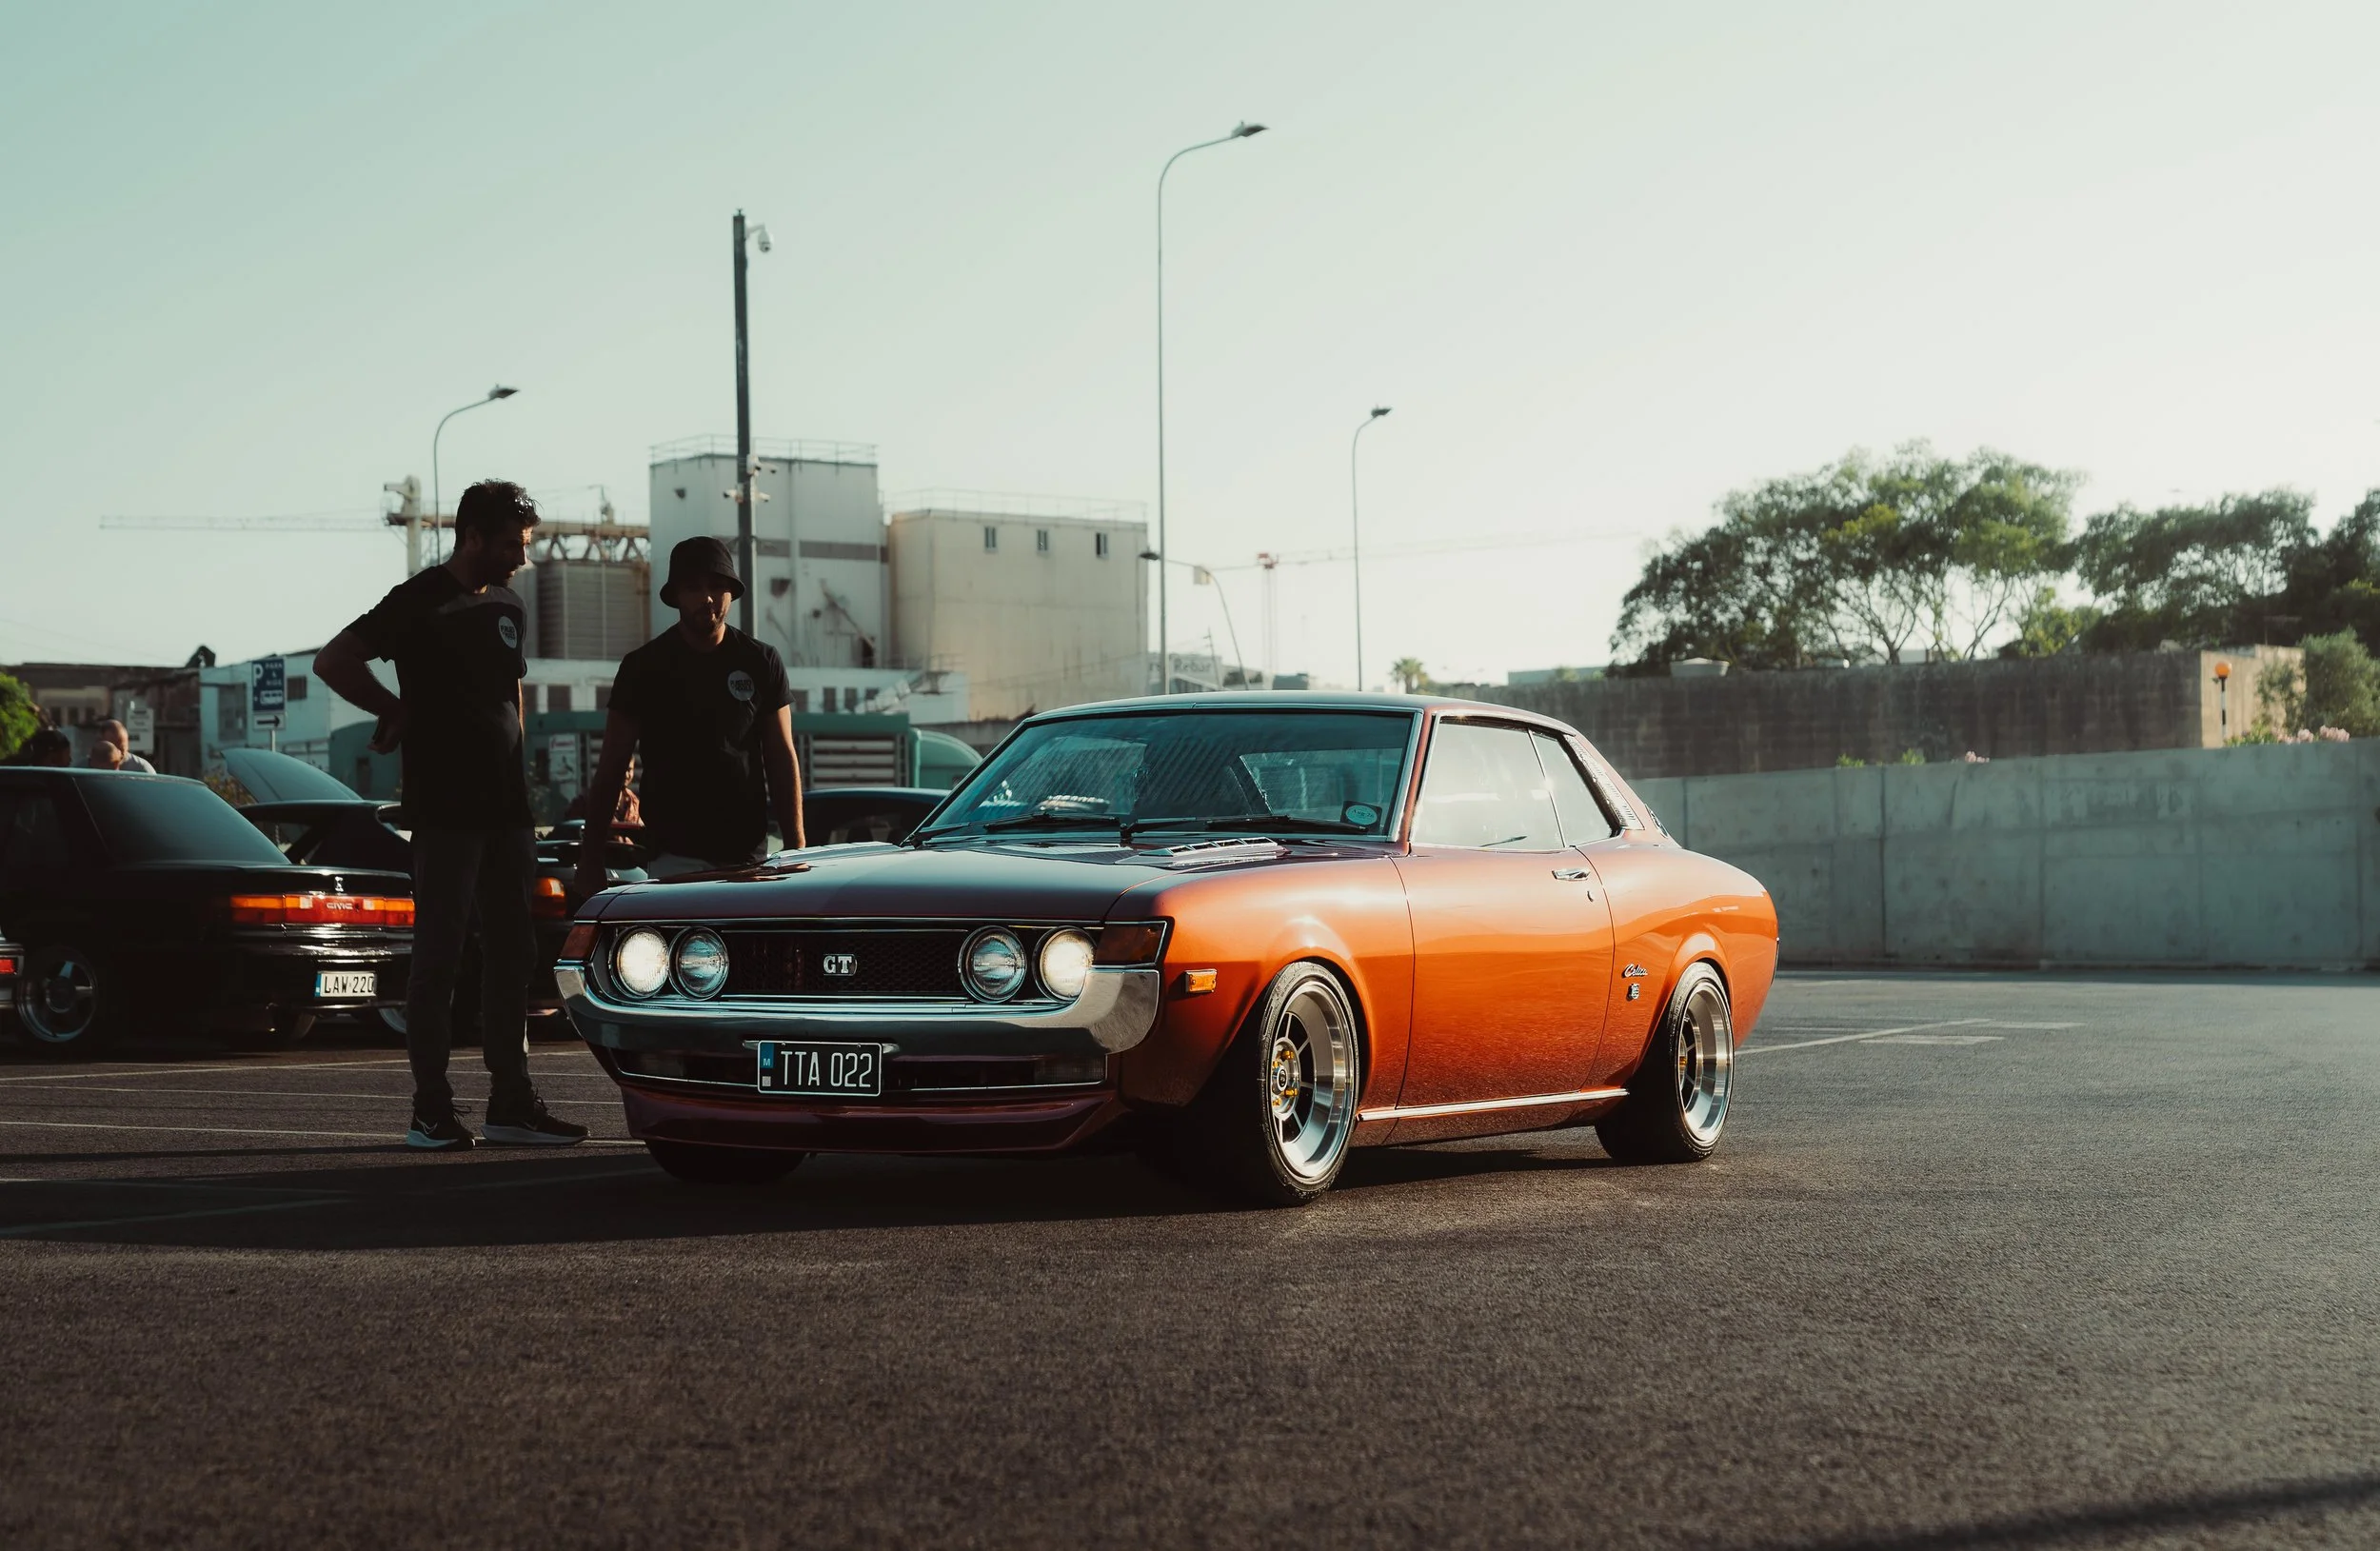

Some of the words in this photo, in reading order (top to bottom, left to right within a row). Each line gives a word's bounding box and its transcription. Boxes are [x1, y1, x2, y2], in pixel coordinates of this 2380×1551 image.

[253, 664, 264, 687] P
[823, 955, 852, 973] GT
[1622, 964, 1648, 977] Celica
[325, 976, 348, 993] LAW
[763, 1058, 771, 1066] M
[781, 1051, 820, 1085] TTA
[830, 1052, 872, 1087] 022
